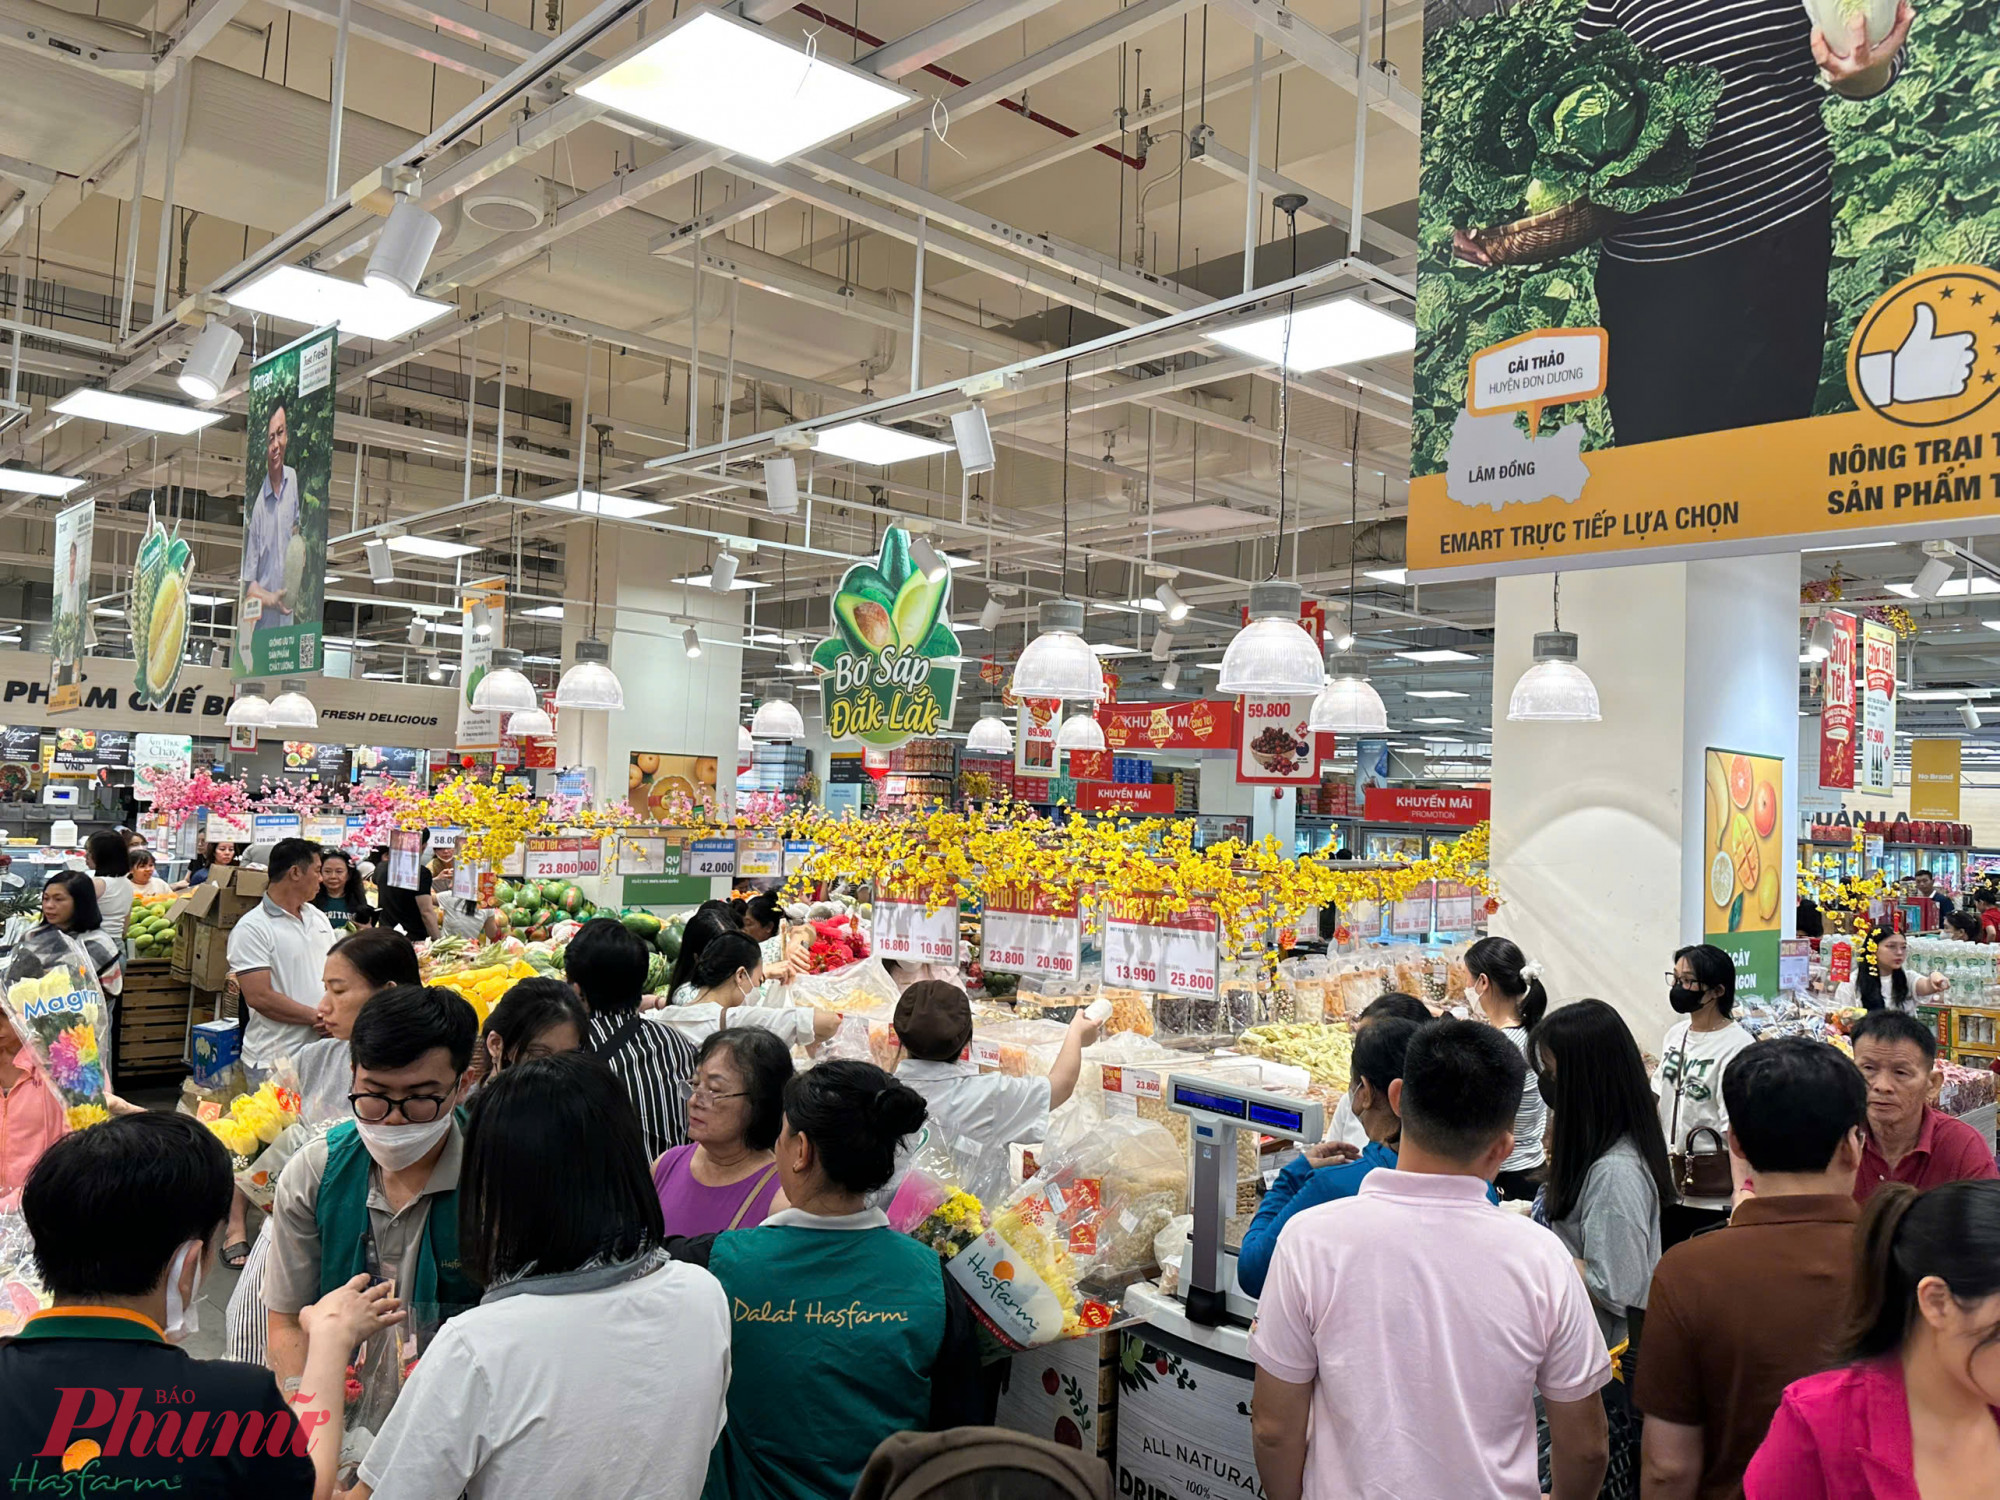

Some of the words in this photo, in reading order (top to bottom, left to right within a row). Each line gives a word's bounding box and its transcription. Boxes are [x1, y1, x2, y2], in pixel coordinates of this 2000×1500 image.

[313, 344, 328, 361] Fresh
[1508, 355, 1528, 374] CẢI
[1532, 350, 1565, 370] THẢO
[254, 369, 273, 391] emart
[1489, 378, 1520, 394] HUYỆN
[1523, 374, 1544, 389] ĐƠN
[1547, 367, 1583, 385] DƯƠNG
[1829, 443, 1906, 476] NÔNG
[1915, 434, 1983, 468] TRẠI
[1469, 465, 1495, 483] LÂM
[1499, 459, 1535, 479] ĐỒNG
[1828, 480, 1883, 515] SẢN
[1894, 466, 1981, 508] PHẨM
[1440, 528, 1504, 555] EMART
[1510, 521, 1566, 550] TRỰC
[1573, 509, 1617, 541] TIẾP
[1624, 510, 1668, 540] LỰA
[1675, 501, 1739, 533] CHỌN
[836, 653, 872, 694] Bơ
[874, 645, 930, 693] Sáp
[4, 674, 117, 709] PHM
[321, 710, 365, 720] FRESH
[368, 714, 438, 725] DELICIOUS
[831, 687, 884, 739] Đắk
[889, 687, 941, 736] Lắk
[1248, 703, 1291, 717] 59.800
[1139, 732, 1183, 741] PRION
[150, 746, 177, 758] Chay
[64, 763, 85, 771] VND
[1930, 773, 1954, 781] Brand
[1098, 787, 1132, 799] KHUYẾN
[1135, 788, 1151, 799] MÃI
[1396, 793, 1446, 808] KHUYẾN
[1449, 796, 1472, 809] MÃI
[434, 836, 456, 844] 58.00
[538, 863, 577, 874] 23.800
[700, 862, 733, 872] 42.000
[880, 938, 909, 952] 16.800
[921, 942, 952, 956] 10.900
[990, 950, 1024, 965] 23.800
[1037, 955, 1072, 971] 20.900
[1116, 965, 1155, 982] 13.990
[1171, 972, 1213, 990] 25.800
[1136, 1081, 1159, 1092] 23.800
[734, 1297, 797, 1322] Dalat
[1143, 1436, 1170, 1457] ALL
[1185, 1479, 1210, 1499] 100%
